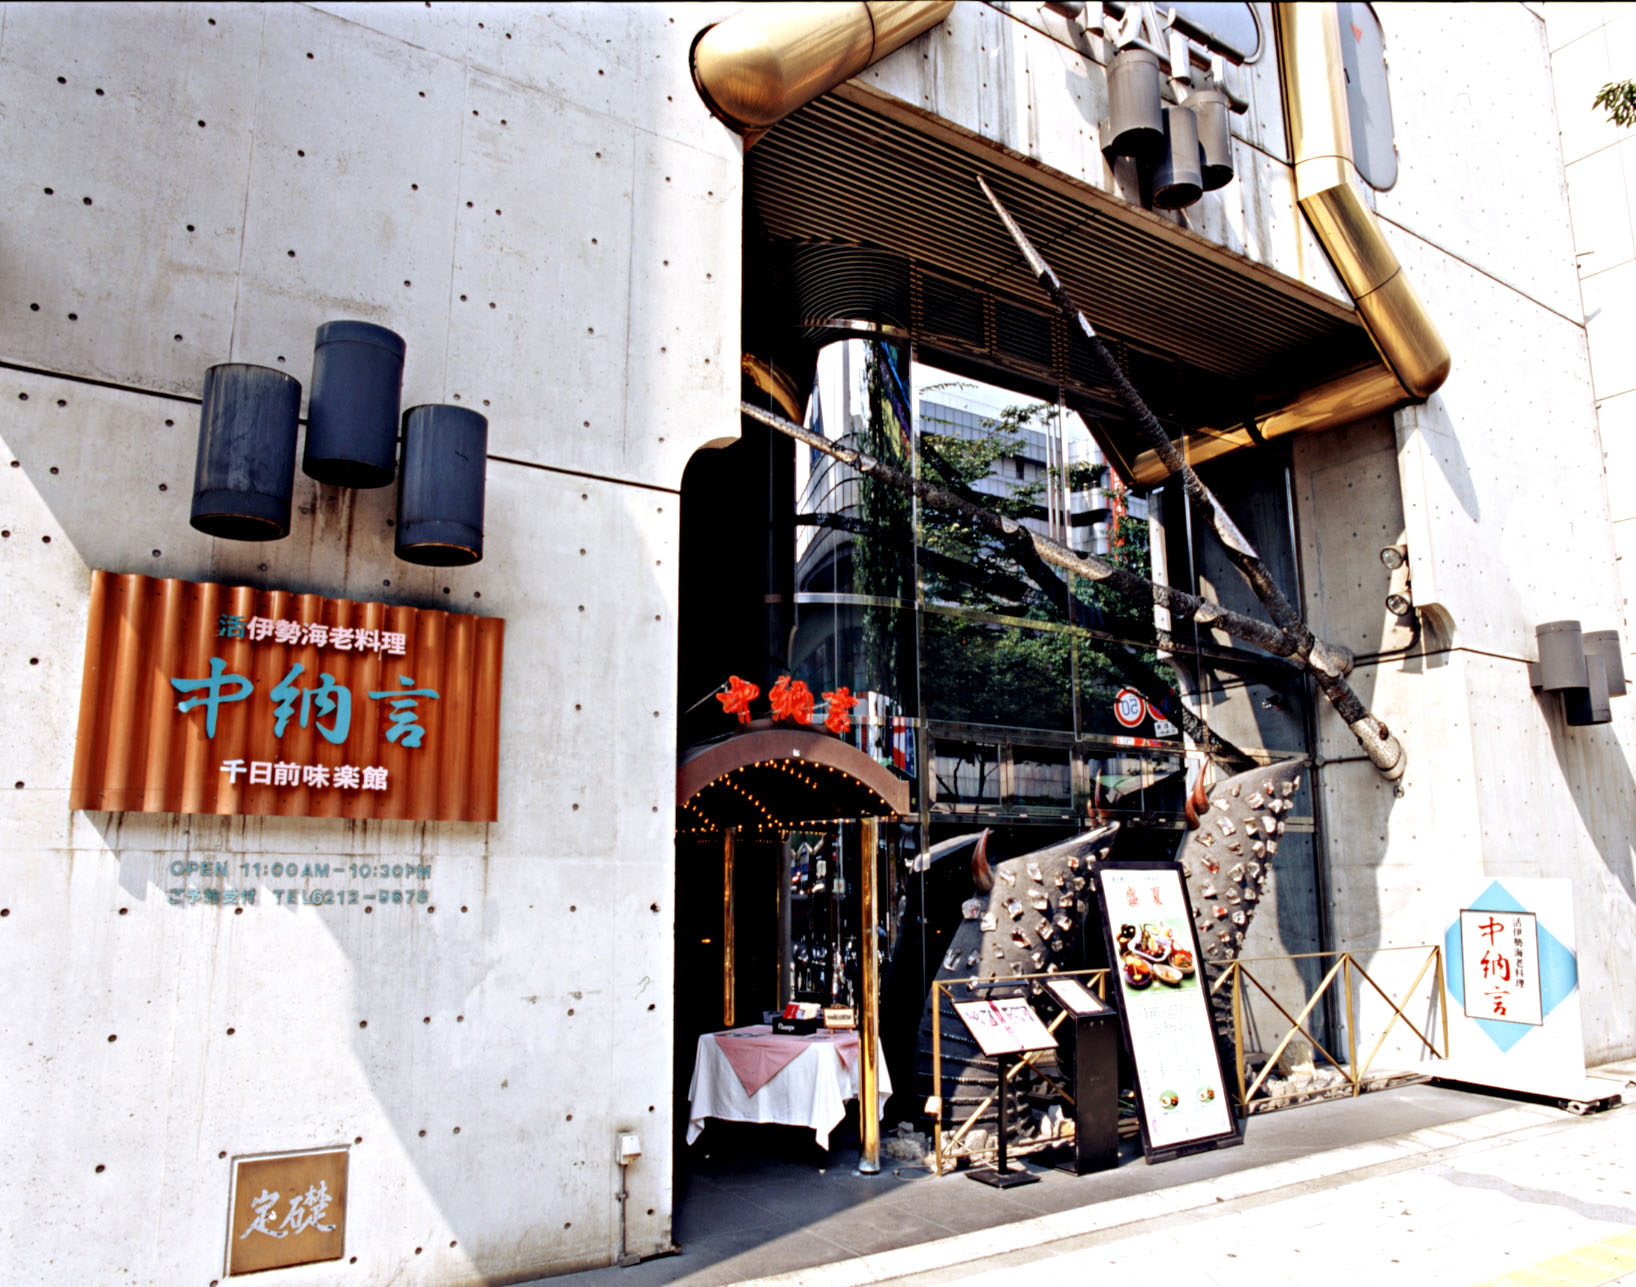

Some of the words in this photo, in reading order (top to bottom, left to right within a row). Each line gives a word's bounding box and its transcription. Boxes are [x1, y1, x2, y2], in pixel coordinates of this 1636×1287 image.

[218, 613, 407, 655] 活伊勢海老料理
[171, 657, 440, 748] 中納言
[219, 758, 389, 791] 千日前味楽館
[169, 860, 229, 877] OPEN
[1478, 916, 1511, 1016] 中納言
